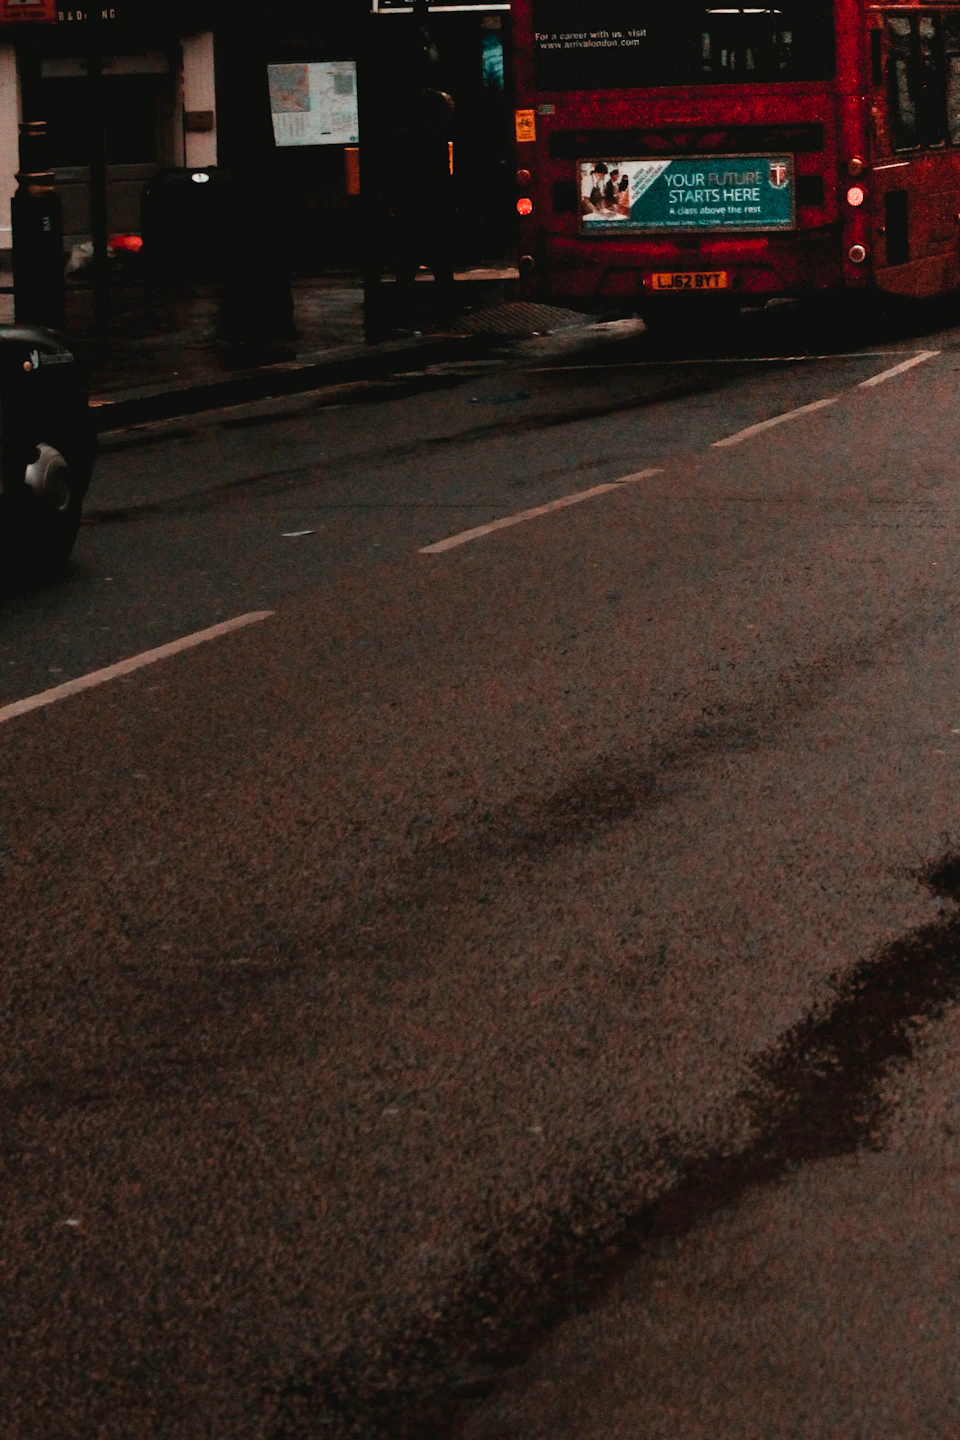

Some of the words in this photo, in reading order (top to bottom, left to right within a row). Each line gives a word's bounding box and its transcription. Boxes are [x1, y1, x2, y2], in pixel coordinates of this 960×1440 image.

[535, 33, 549, 41] For
[560, 32, 587, 40] career
[590, 30, 609, 39] with
[628, 29, 647, 37] visit
[540, 39, 640, 49] www.arrivalondon.com
[664, 174, 705, 187] YOUR
[708, 172, 763, 186] FUTURE
[669, 189, 720, 203] STARTS
[723, 188, 760, 201] HERE
[677, 206, 698, 214] class
[700, 205, 726, 214] above
[728, 205, 742, 213] the
[744, 205, 761, 213] rest
[658, 275, 691, 288] LJ62
[695, 274, 720, 288] BYT
